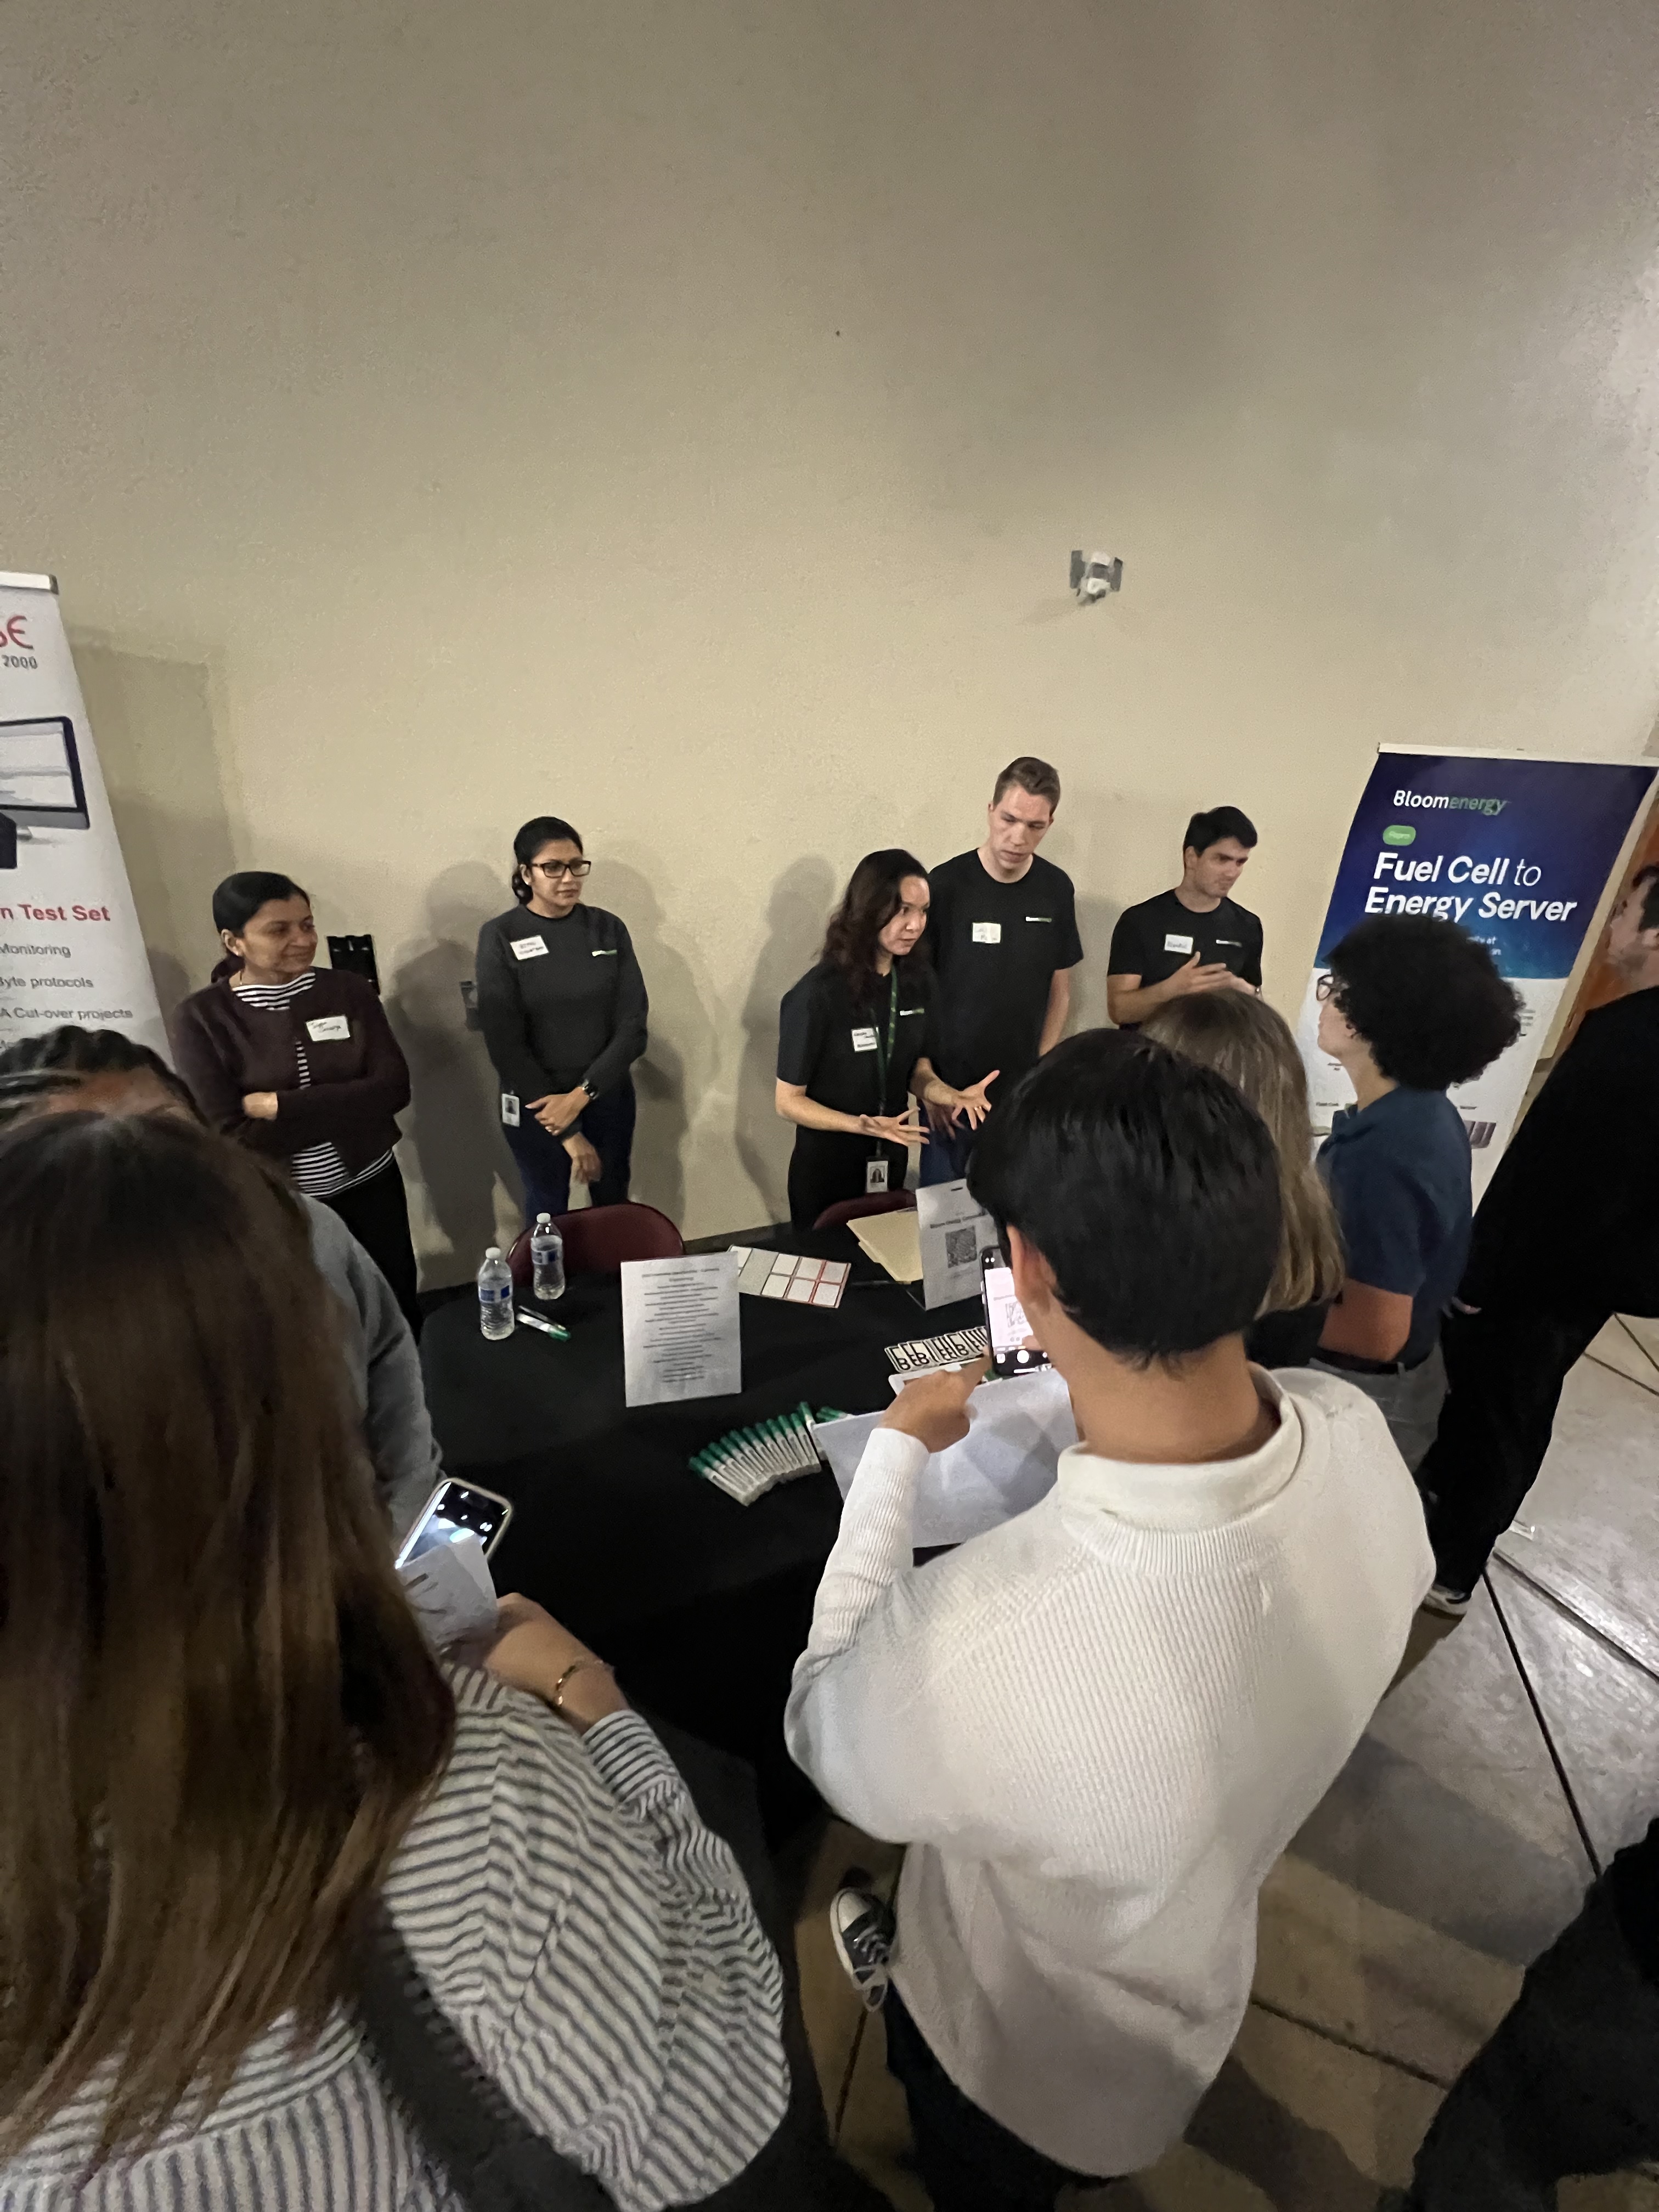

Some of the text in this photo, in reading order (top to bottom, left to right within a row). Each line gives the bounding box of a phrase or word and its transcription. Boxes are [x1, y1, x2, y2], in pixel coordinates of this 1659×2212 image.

[1, 654, 38, 669] 2000
[1393, 789, 1508, 816] Bloomenergy
[1373, 851, 1542, 887] Fuel Cell to
[17, 904, 67, 921] Test
[72, 905, 111, 922] Set
[1364, 886, 1578, 923] Energy Server
[30, 977, 94, 989] protocols
[14, 1007, 74, 1019] Cut-over
[77, 1008, 133, 1021] projects
